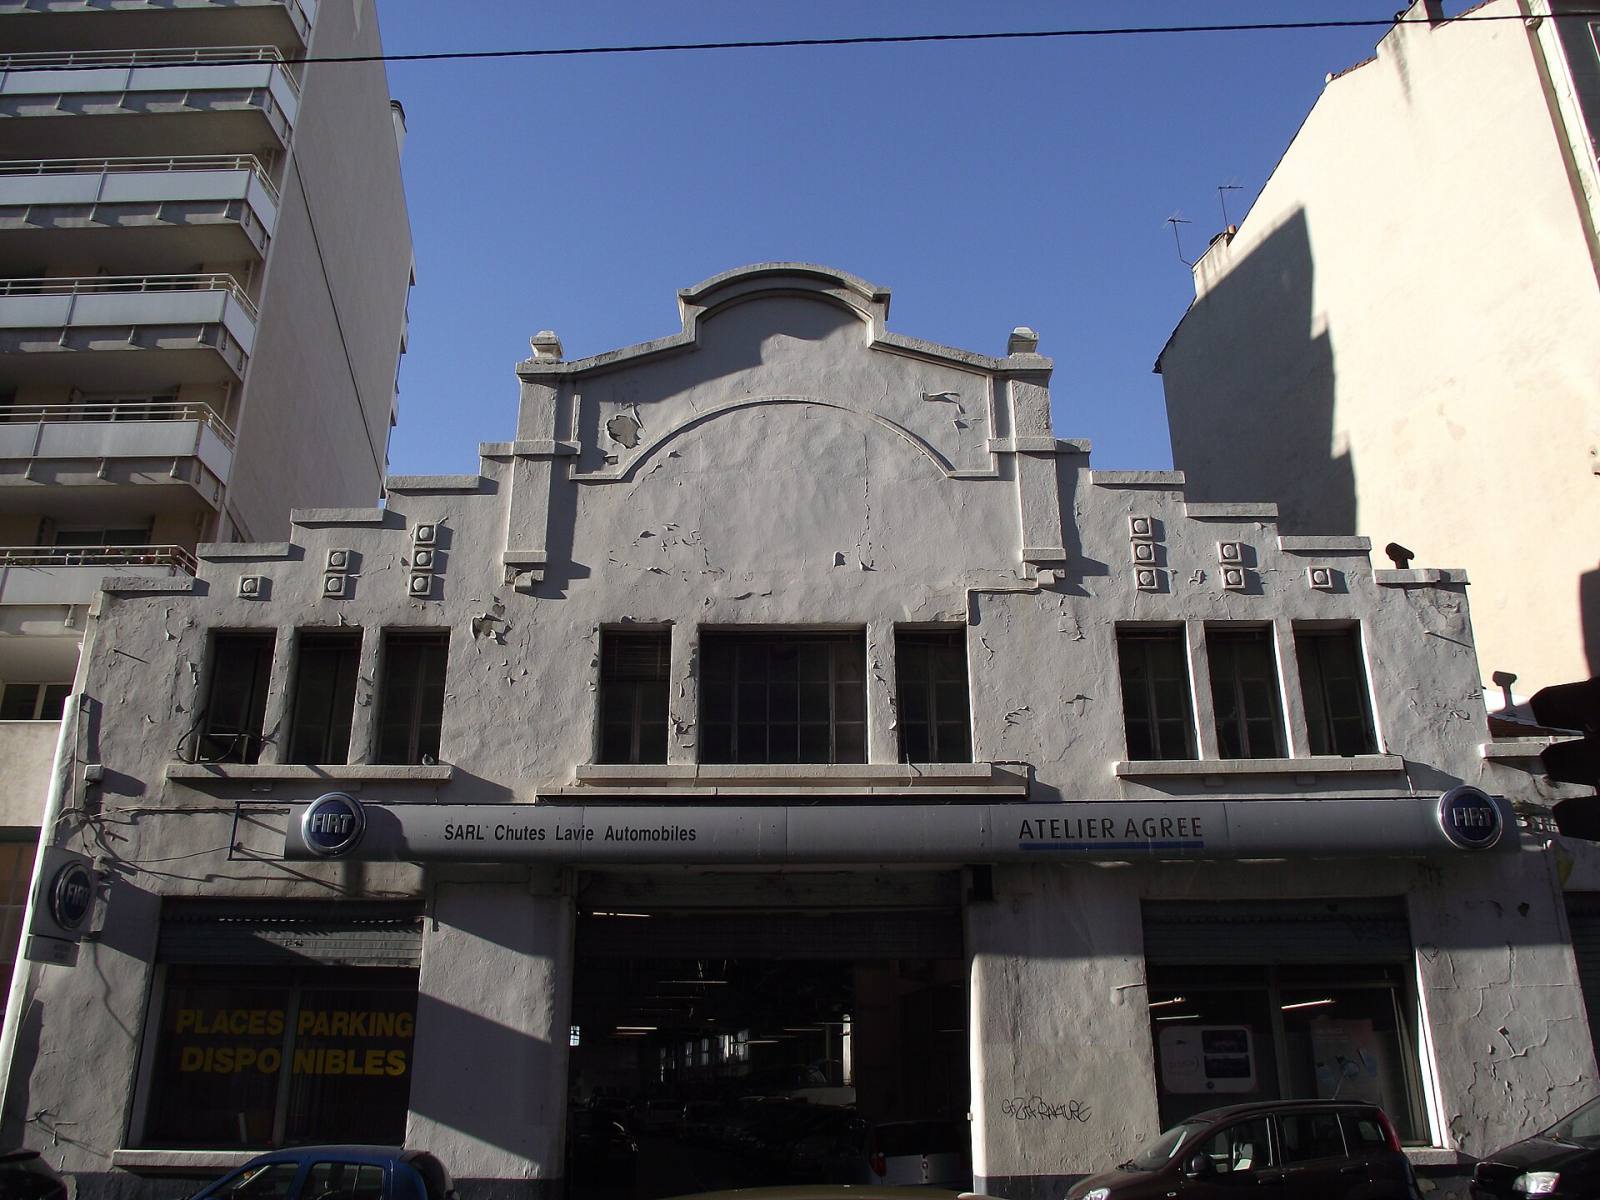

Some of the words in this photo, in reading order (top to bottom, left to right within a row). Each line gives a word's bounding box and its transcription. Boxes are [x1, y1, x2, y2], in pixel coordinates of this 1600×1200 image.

[313, 813, 353, 834] FIAT
[1452, 807, 1492, 827] FIAT
[445, 825, 484, 839] SARL
[494, 823, 546, 840] Chutes
[555, 824, 595, 840] Lavie
[605, 824, 696, 841] Automobiles
[1019, 818, 1116, 839] ATELIER
[1124, 817, 1203, 837] AGREE
[177, 1009, 285, 1036] PLACES
[298, 1010, 414, 1038] PARKING
